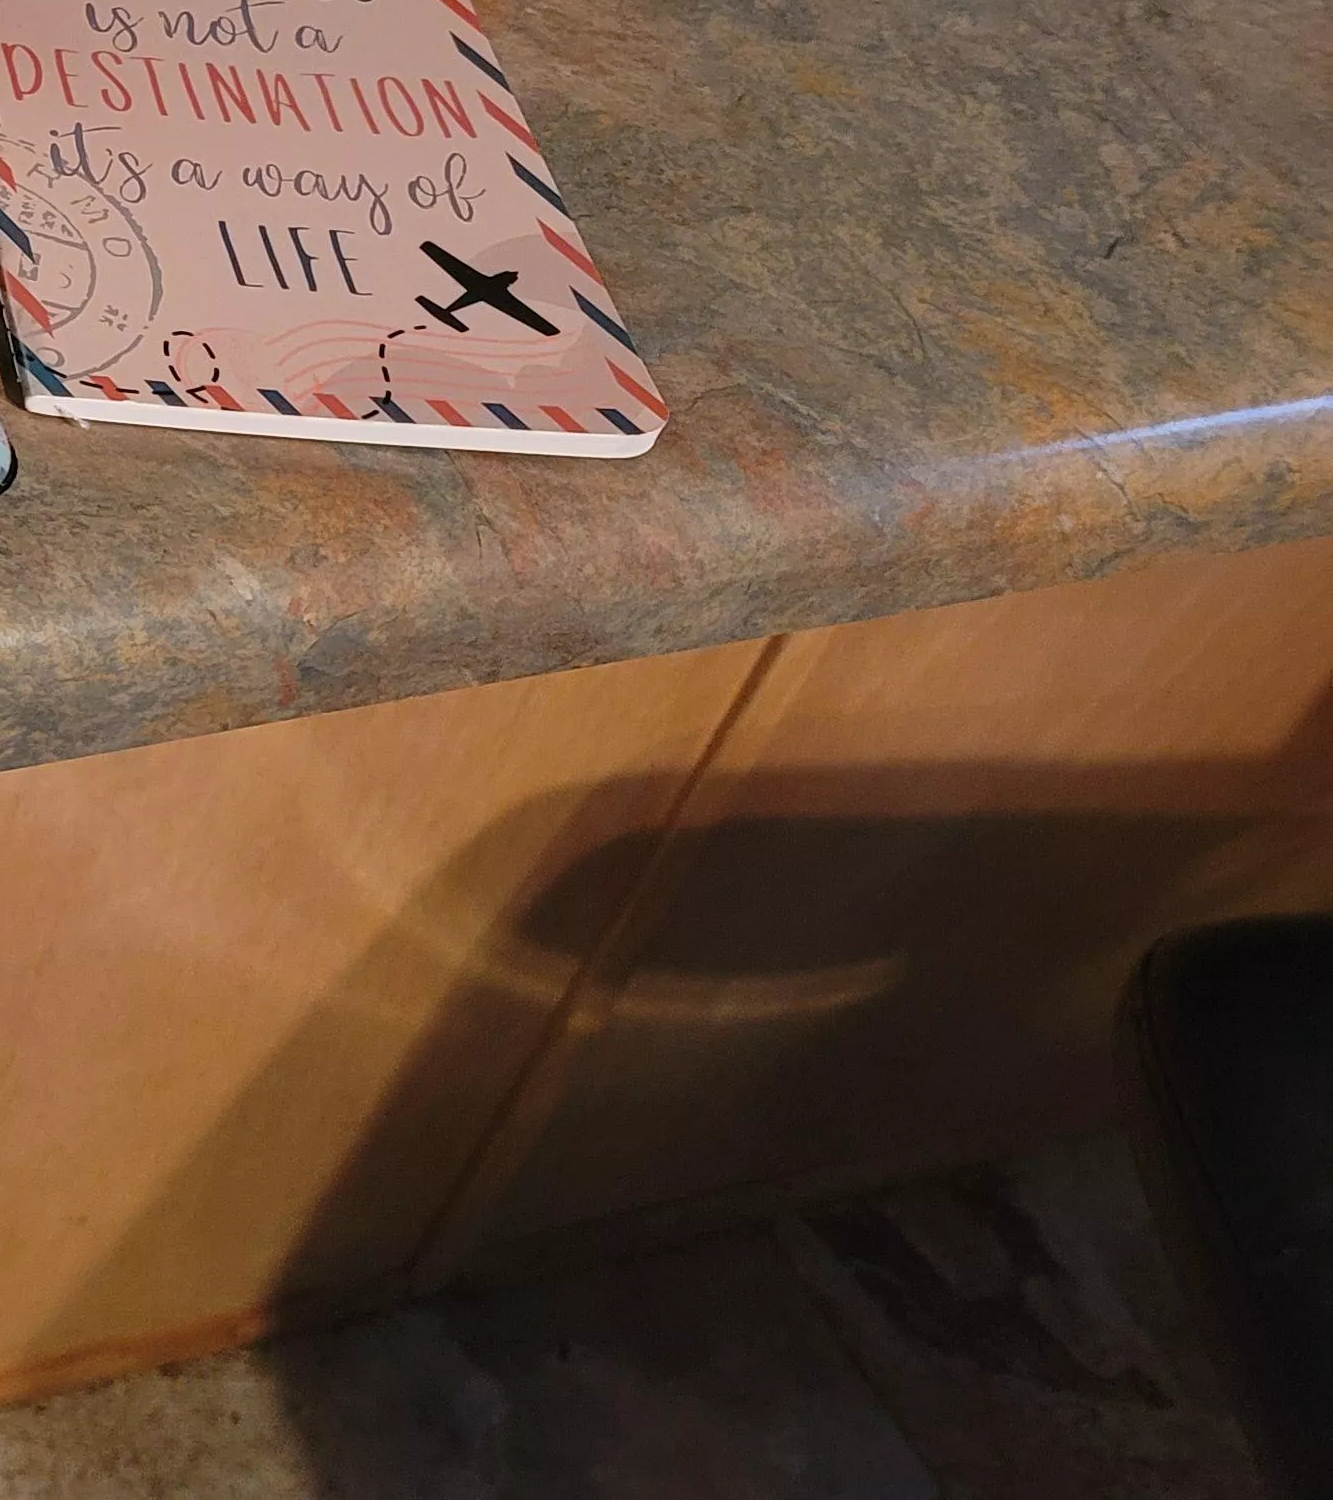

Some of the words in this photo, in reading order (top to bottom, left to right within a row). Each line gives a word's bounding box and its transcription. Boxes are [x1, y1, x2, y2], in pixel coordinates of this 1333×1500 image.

[295, 24, 344, 53] a
[1, 43, 478, 141] DESTINATION
[49, 122, 153, 202] it's
[170, 156, 225, 188] a
[241, 169, 389, 236] way
[407, 152, 486, 222] of
[218, 220, 374, 298] LIFE
